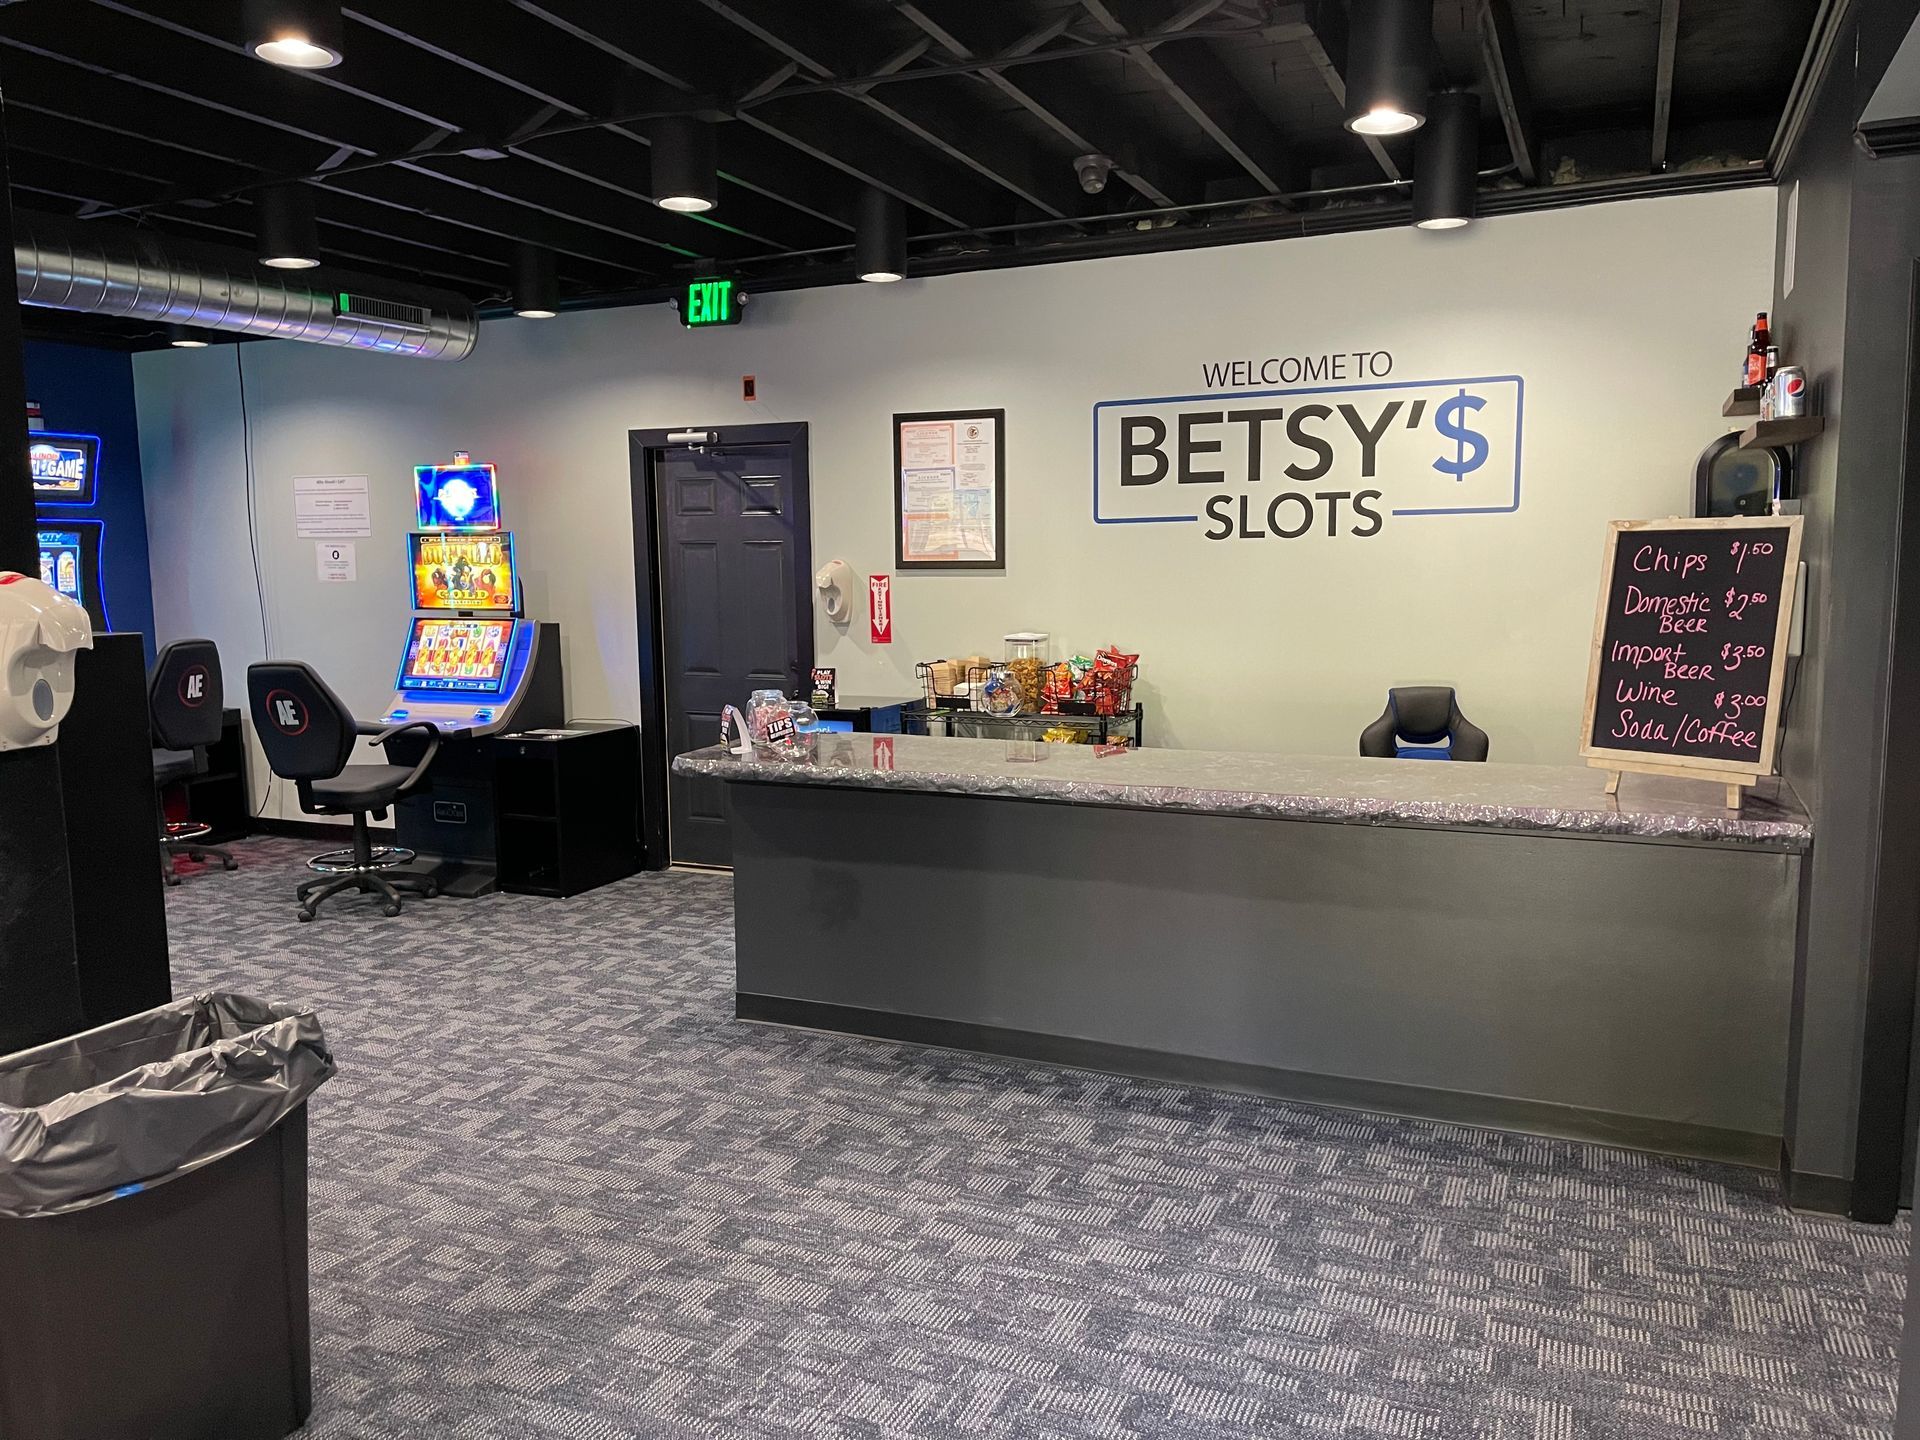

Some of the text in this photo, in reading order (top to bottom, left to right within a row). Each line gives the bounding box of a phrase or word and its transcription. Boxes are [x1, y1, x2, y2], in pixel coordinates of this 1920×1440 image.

[688, 281, 731, 323] EXIT
[1203, 351, 1393, 388] WELCOME TO
[47, 458, 84, 480] GAME
[1204, 490, 1383, 541] SLOTS
[1633, 541, 1773, 579] Chips $1.50
[436, 589, 489, 601] GOLD
[1624, 585, 1768, 620] Domestic $2.50
[1721, 642, 1766, 671] $3.50
[1616, 679, 1678, 706] Wine
[767, 717, 793, 734] TIPS
